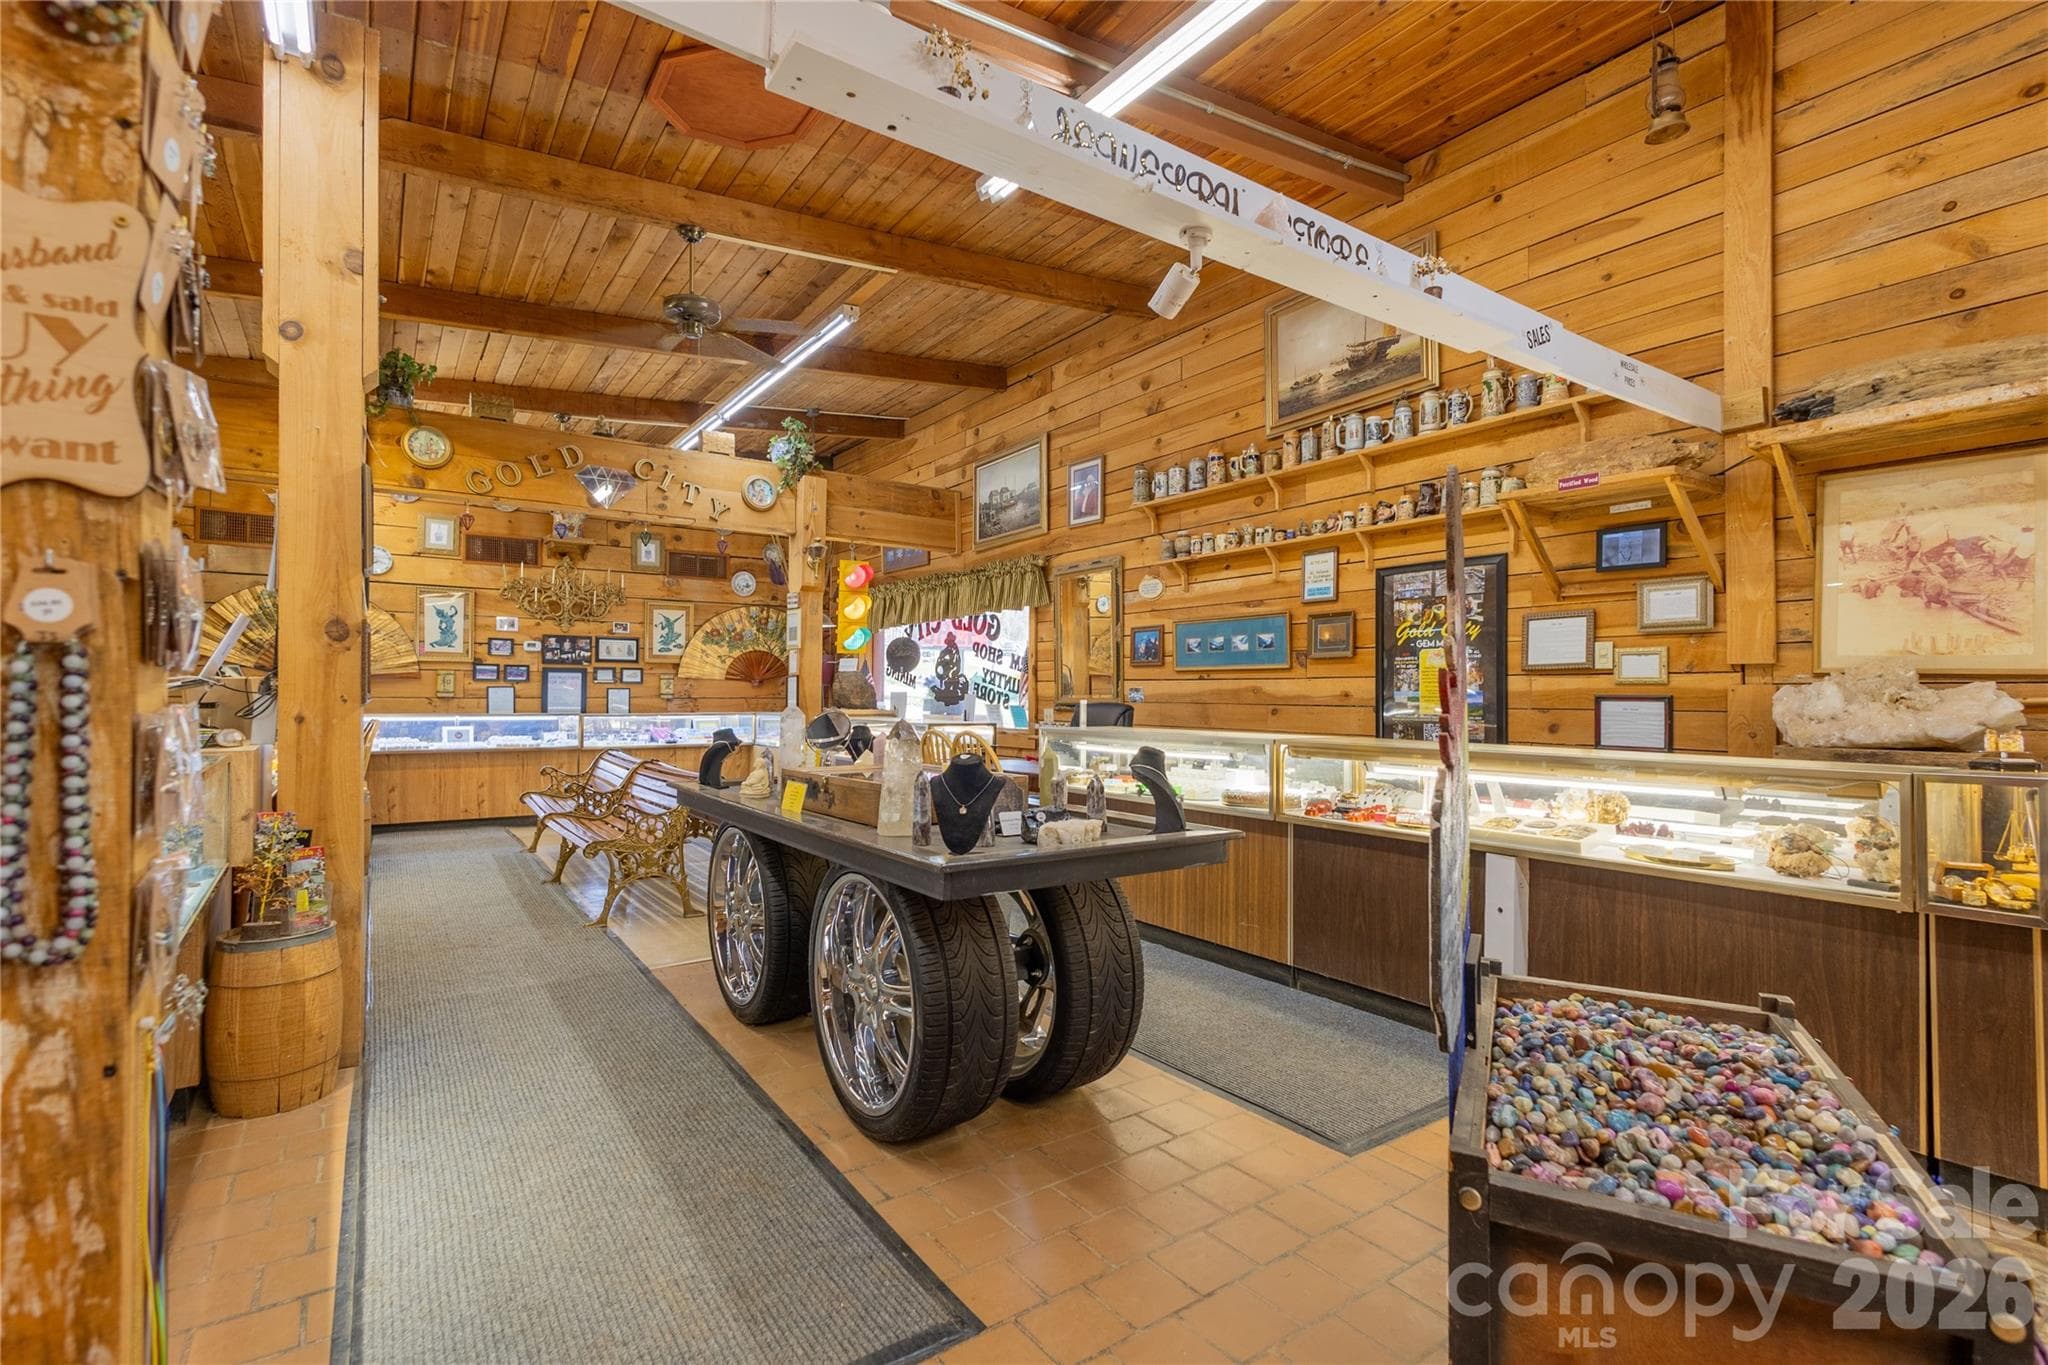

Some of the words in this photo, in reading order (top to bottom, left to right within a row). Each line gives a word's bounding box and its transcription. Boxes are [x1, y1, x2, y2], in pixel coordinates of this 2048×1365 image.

[41, 292, 119, 318] said
[1526, 324, 1551, 350] SALES
[465, 444, 585, 496] GOLD
[634, 458, 731, 521] CITY
[1583, 476, 1598, 485] Wood
[1396, 620, 1437, 646] Gold
